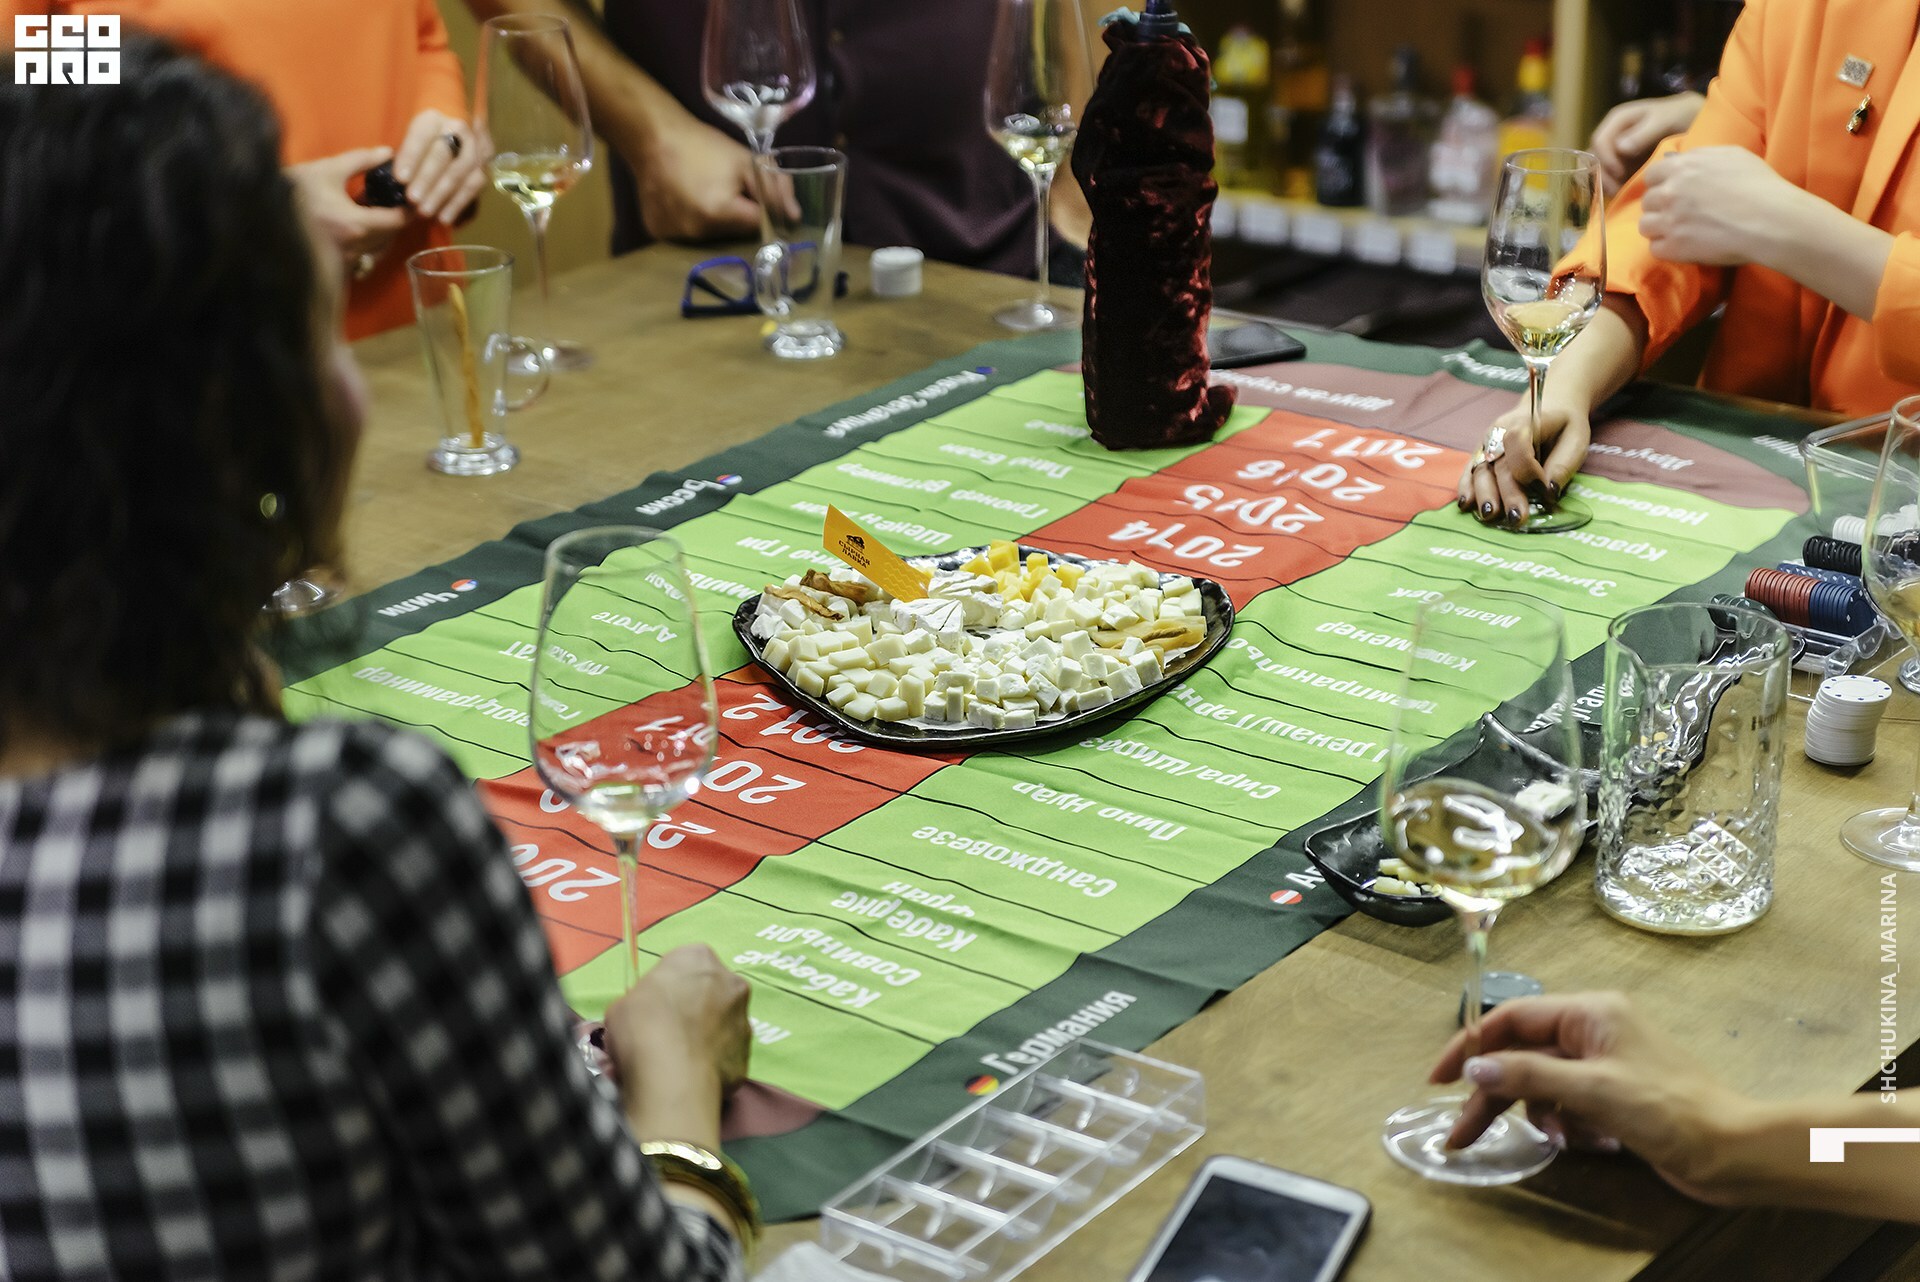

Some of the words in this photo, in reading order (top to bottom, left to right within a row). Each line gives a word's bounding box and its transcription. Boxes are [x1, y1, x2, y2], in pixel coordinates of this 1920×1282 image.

[857, 511, 953, 546] Шенен
[1173, 484, 1325, 534] 2015
[736, 536, 790, 558] Гри
[839, 540, 871, 566] СЫРНАЯ
[841, 549, 867, 569] ЛАВКА
[1107, 518, 1264, 568] 2014
[376, 590, 458, 618] Чили
[721, 692, 866, 754] 2012
[1078, 736, 1282, 800] Сира/Шираз
[1011, 781, 1093, 816] Нуар
[1096, 805, 1188, 842] Пино
[910, 824, 1118, 900] Санджовезе
[830, 890, 978, 953] Каберне
[755, 923, 922, 987] Совиньон
[978, 990, 1137, 1076] Германия
